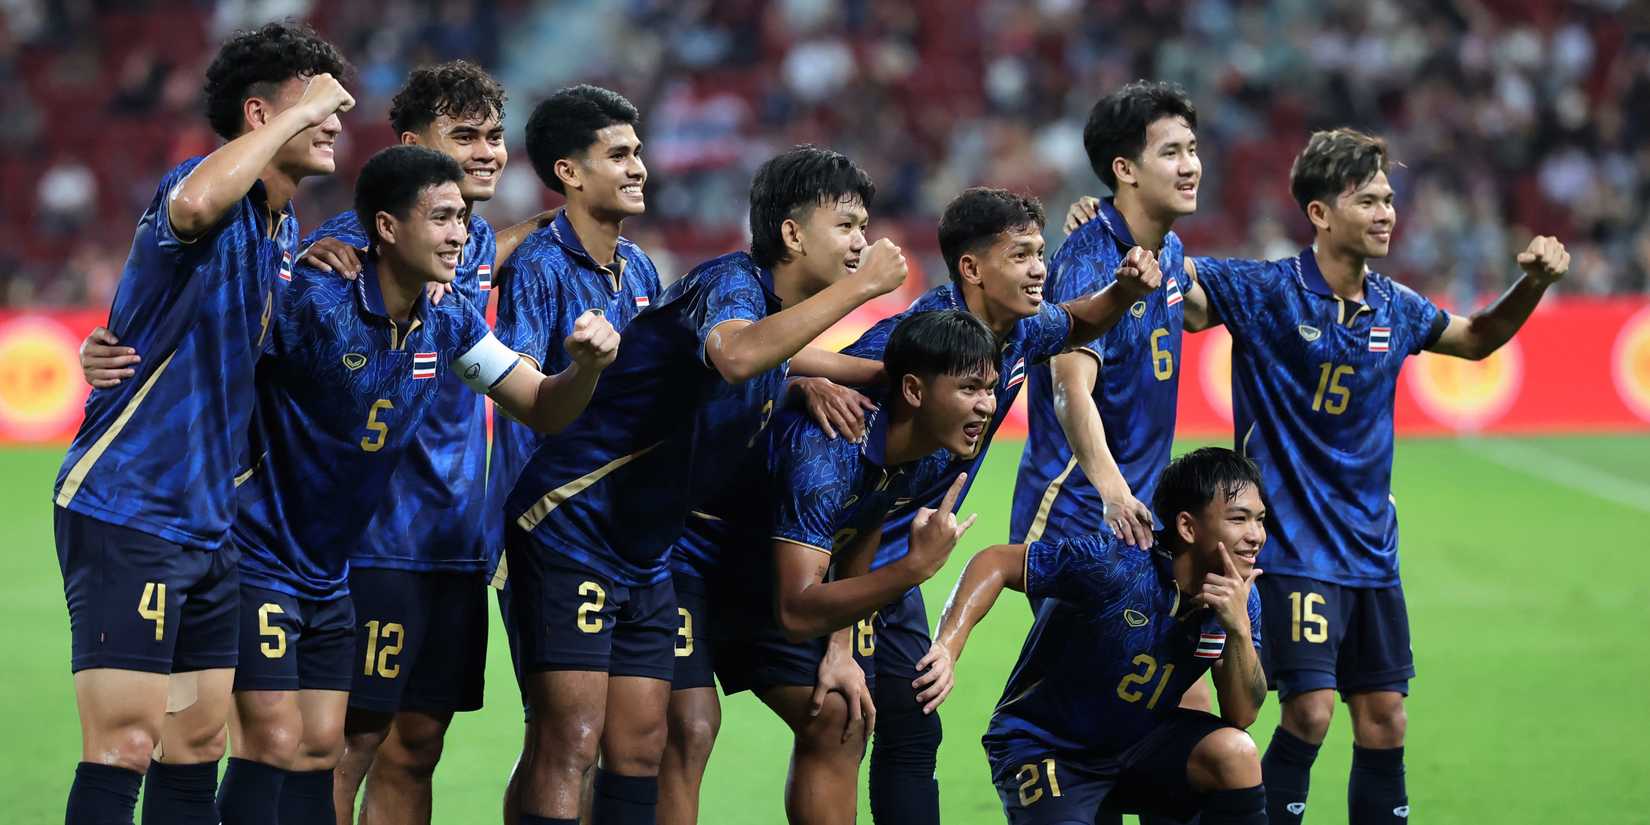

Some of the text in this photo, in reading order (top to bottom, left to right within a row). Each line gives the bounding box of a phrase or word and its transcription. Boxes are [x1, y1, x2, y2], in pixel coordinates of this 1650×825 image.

[1151, 327, 1173, 381] 6
[1312, 362, 1354, 415] 15
[360, 399, 394, 451] 5
[137, 582, 166, 640] 4
[258, 603, 287, 658] 5
[577, 580, 605, 633] 2
[1288, 591, 1328, 644] 15
[363, 620, 405, 679] 12
[1116, 653, 1175, 710] 21
[1016, 758, 1061, 807] 21
